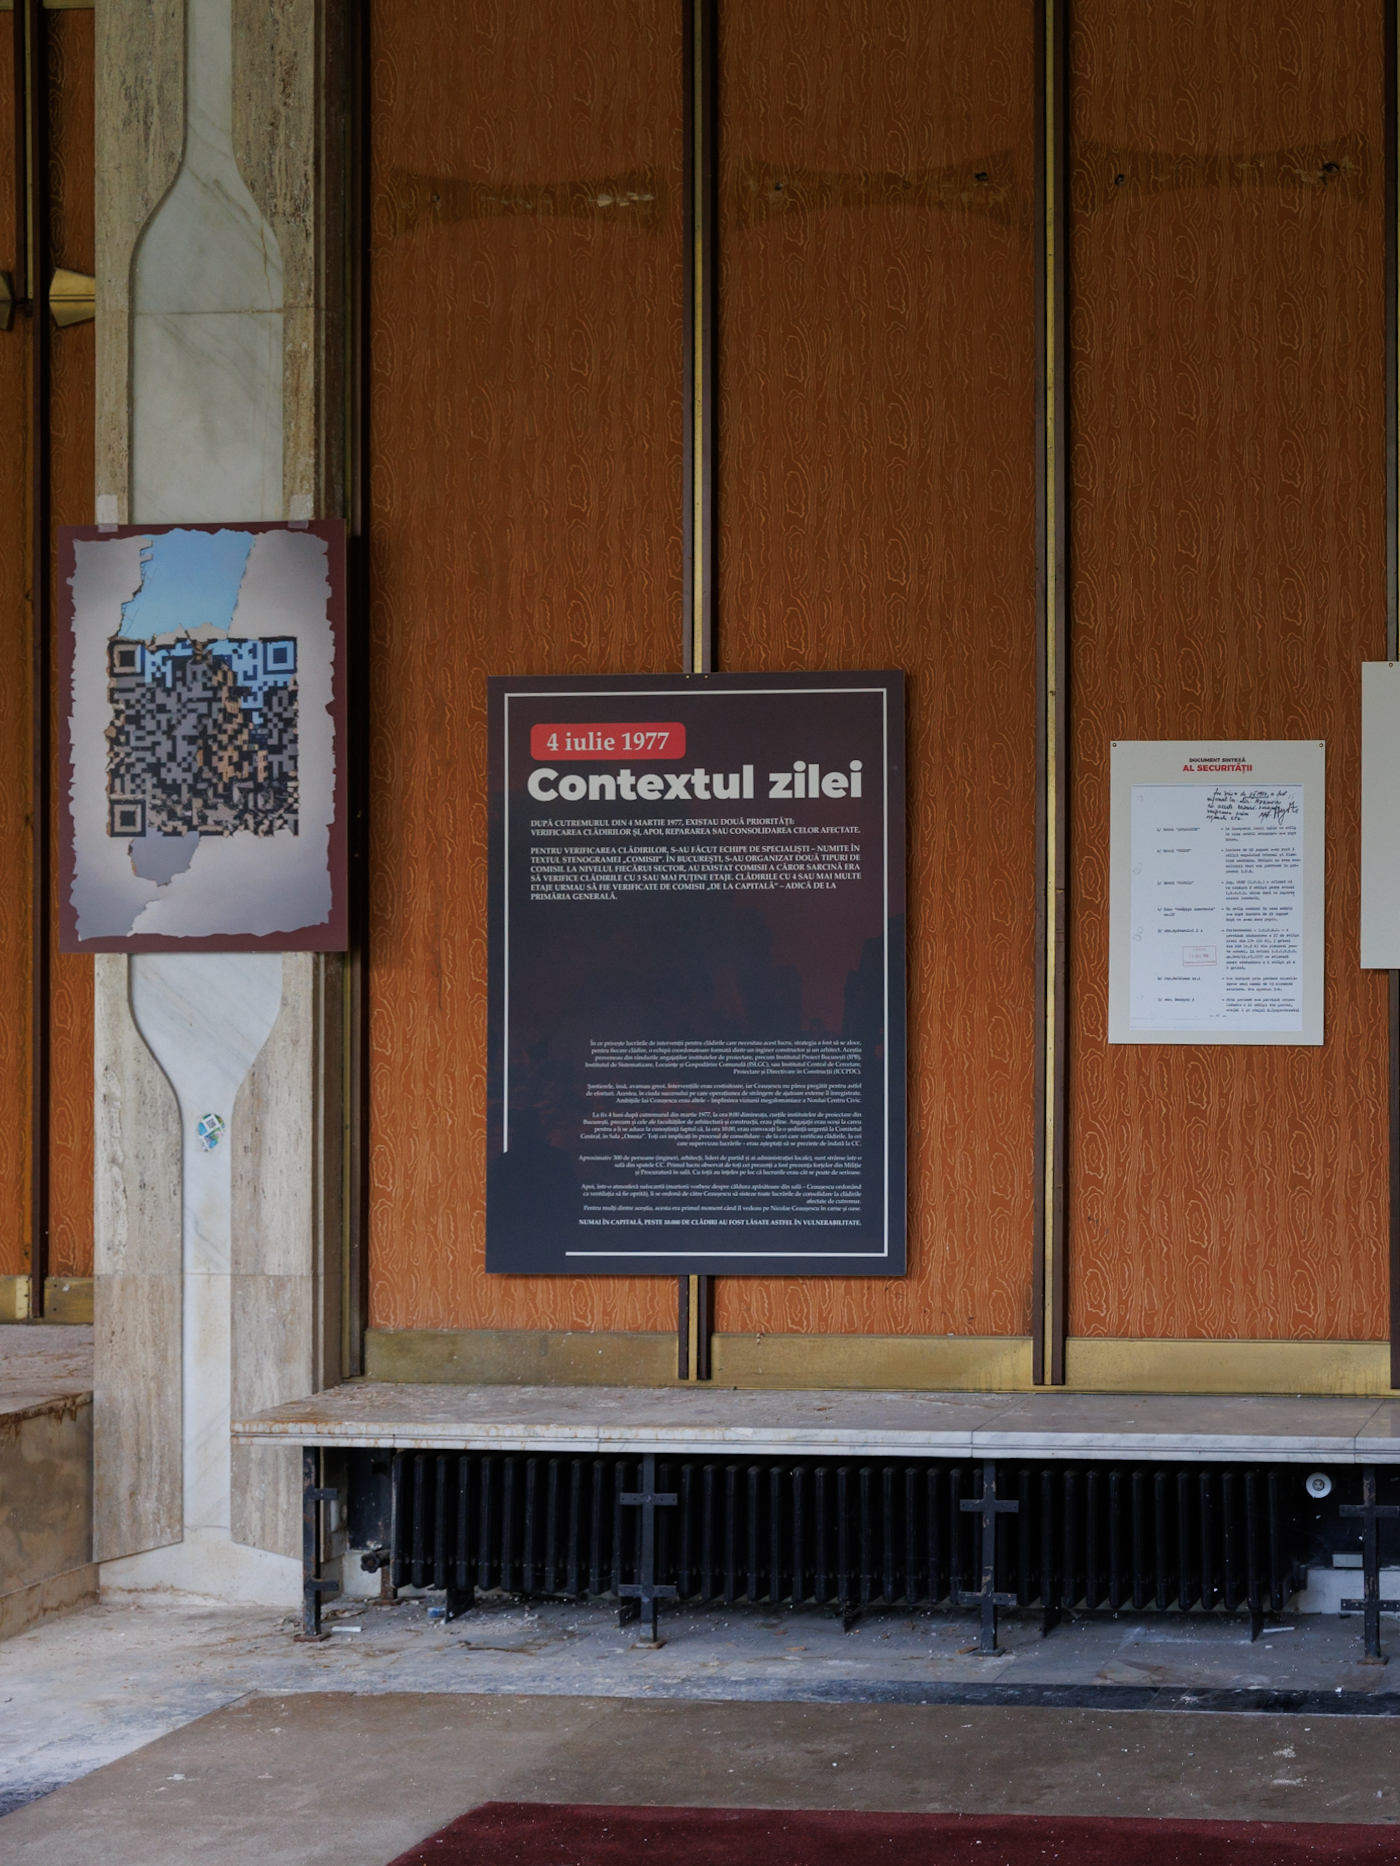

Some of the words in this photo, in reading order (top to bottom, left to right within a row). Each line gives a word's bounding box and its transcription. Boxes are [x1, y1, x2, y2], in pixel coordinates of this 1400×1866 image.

[547, 733, 559, 751] 4
[565, 732, 615, 751] iulie
[622, 732, 669, 750] 1977
[1197, 763, 1252, 774] SECURITĂȚII
[528, 765, 754, 801] Contextul
[769, 760, 862, 798] zilei
[746, 817, 794, 826] PRIORITĂȚI:
[618, 845, 668, 854] CLĂDIRILOR,
